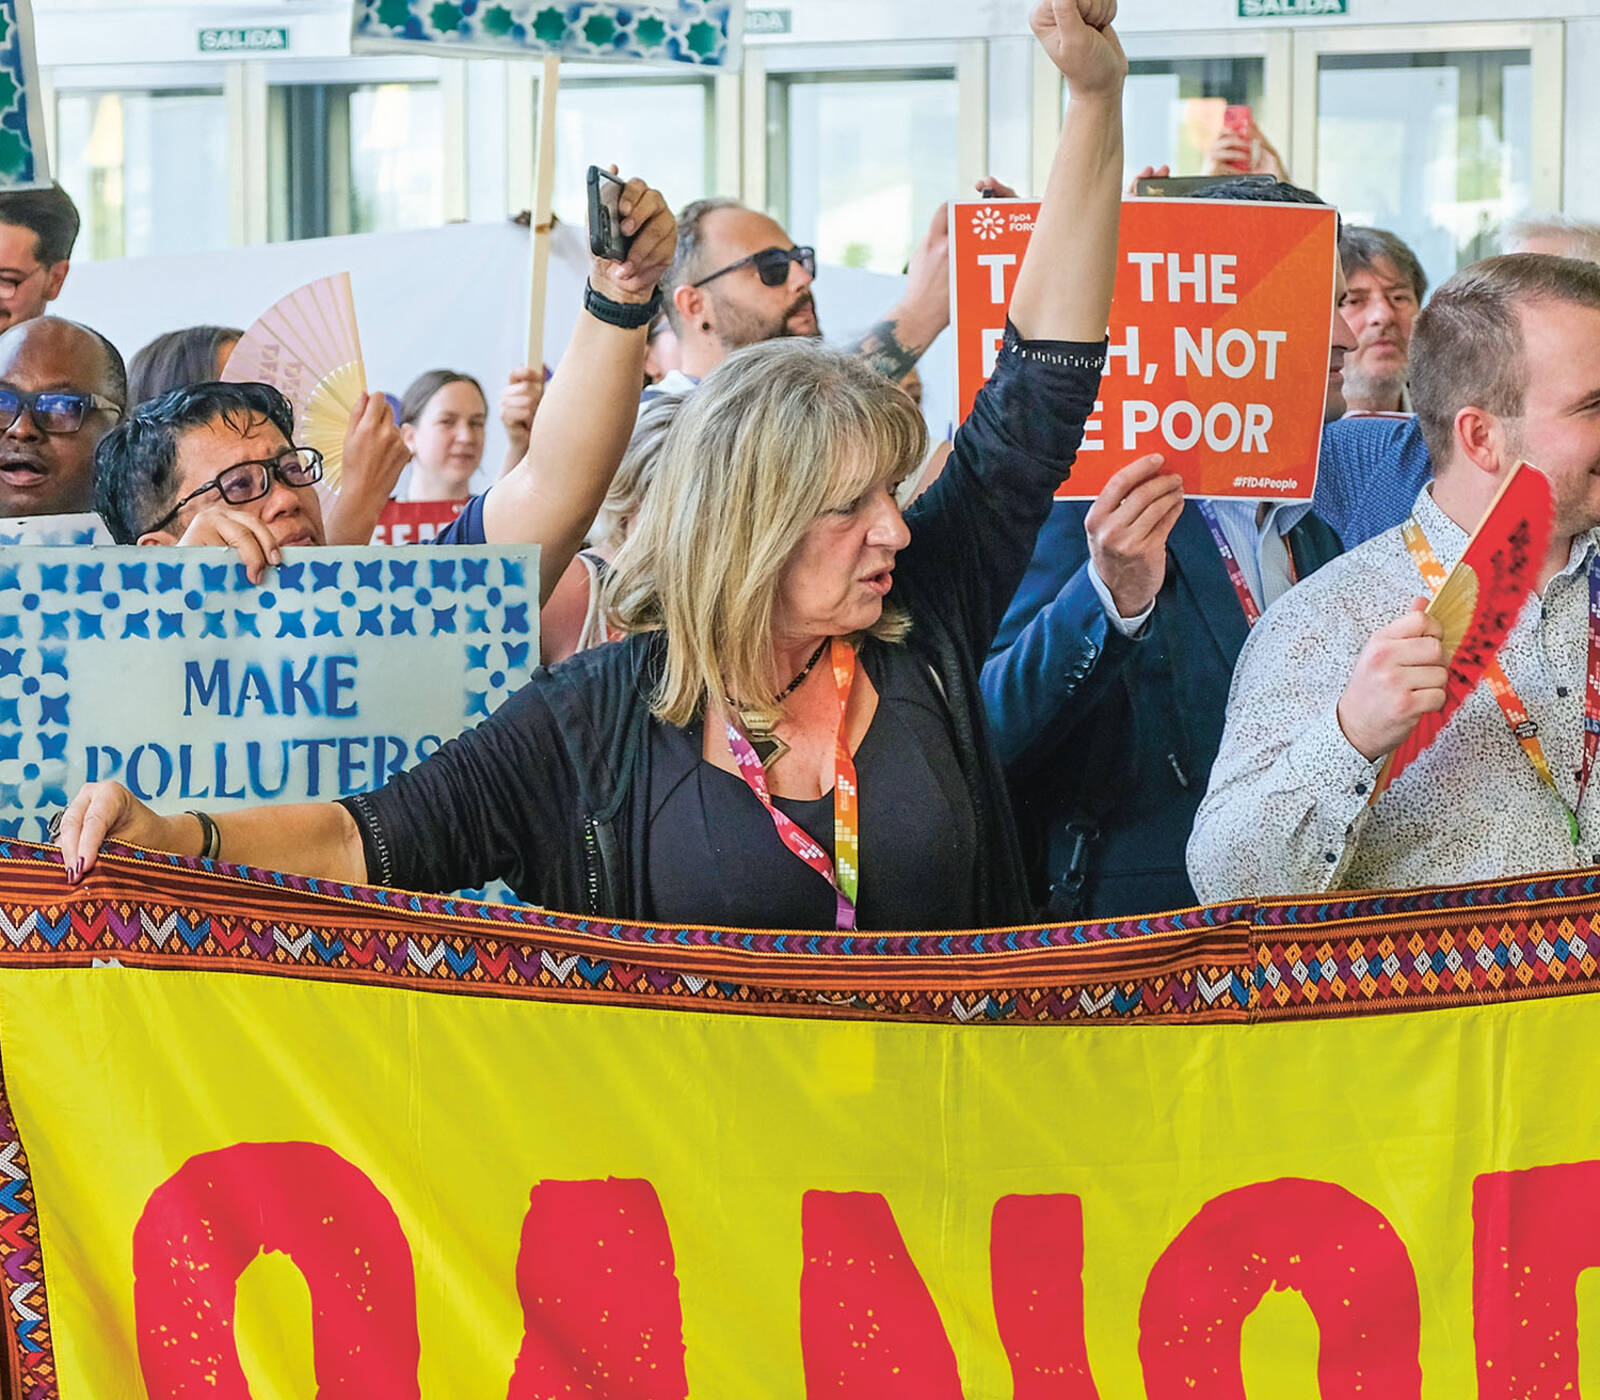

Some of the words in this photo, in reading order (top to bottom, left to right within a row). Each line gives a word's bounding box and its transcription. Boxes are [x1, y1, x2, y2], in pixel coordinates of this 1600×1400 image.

[203, 30, 283, 48] SALIDA
[1128, 252, 1238, 304] THE
[1174, 327, 1287, 380] NOT
[1122, 400, 1274, 453] POOR
[183, 654, 358, 718] MAKE
